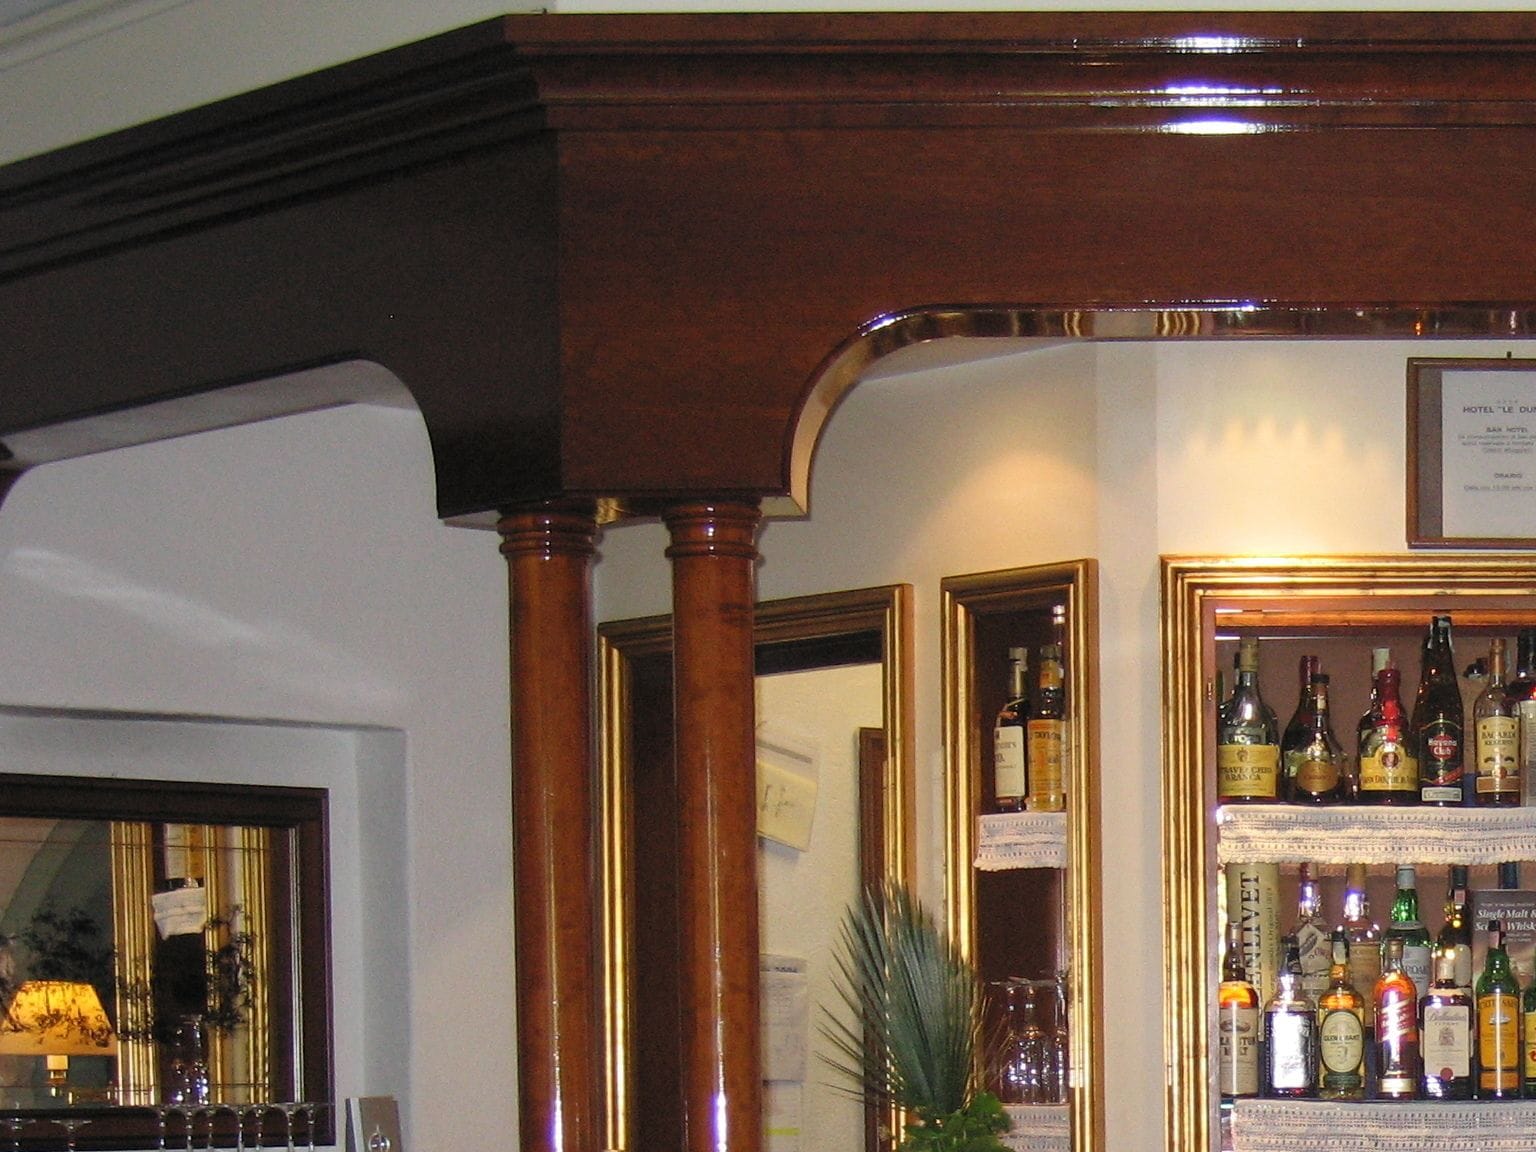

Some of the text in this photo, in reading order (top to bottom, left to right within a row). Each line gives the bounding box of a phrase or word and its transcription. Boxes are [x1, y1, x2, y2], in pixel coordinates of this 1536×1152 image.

[1462, 406, 1495, 414] HOTEL
[1477, 909, 1506, 920] Single
[1506, 909, 1528, 918] Malt
